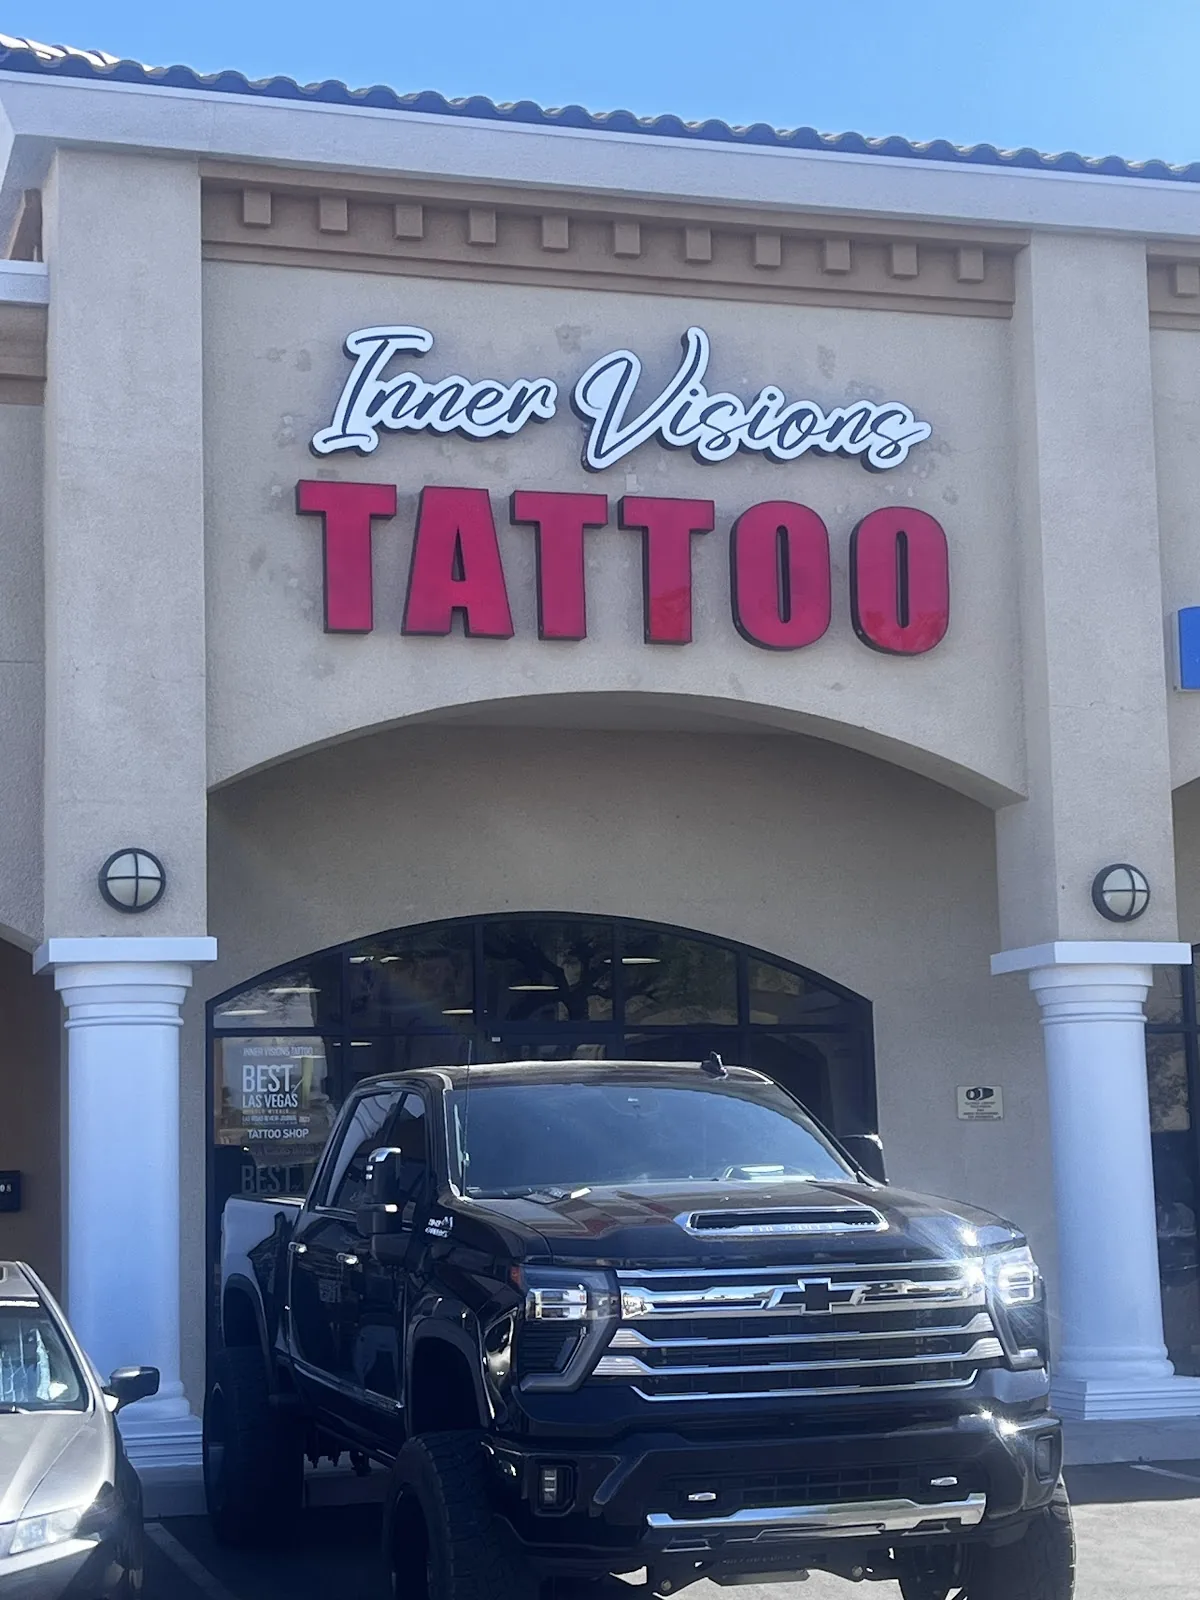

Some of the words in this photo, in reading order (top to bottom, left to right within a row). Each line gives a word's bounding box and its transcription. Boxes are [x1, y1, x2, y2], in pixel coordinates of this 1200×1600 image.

[310, 325, 557, 456] Inner
[575, 326, 932, 472] Visions
[297, 479, 950, 656] TATTOO
[242, 1064, 293, 1092] BEST
[242, 1094, 262, 1108] LAS
[264, 1093, 298, 1108] VEGAS
[248, 1129, 282, 1139] TATTOO
[283, 1128, 309, 1138] SHOP
[242, 1165, 291, 1193] BEST
